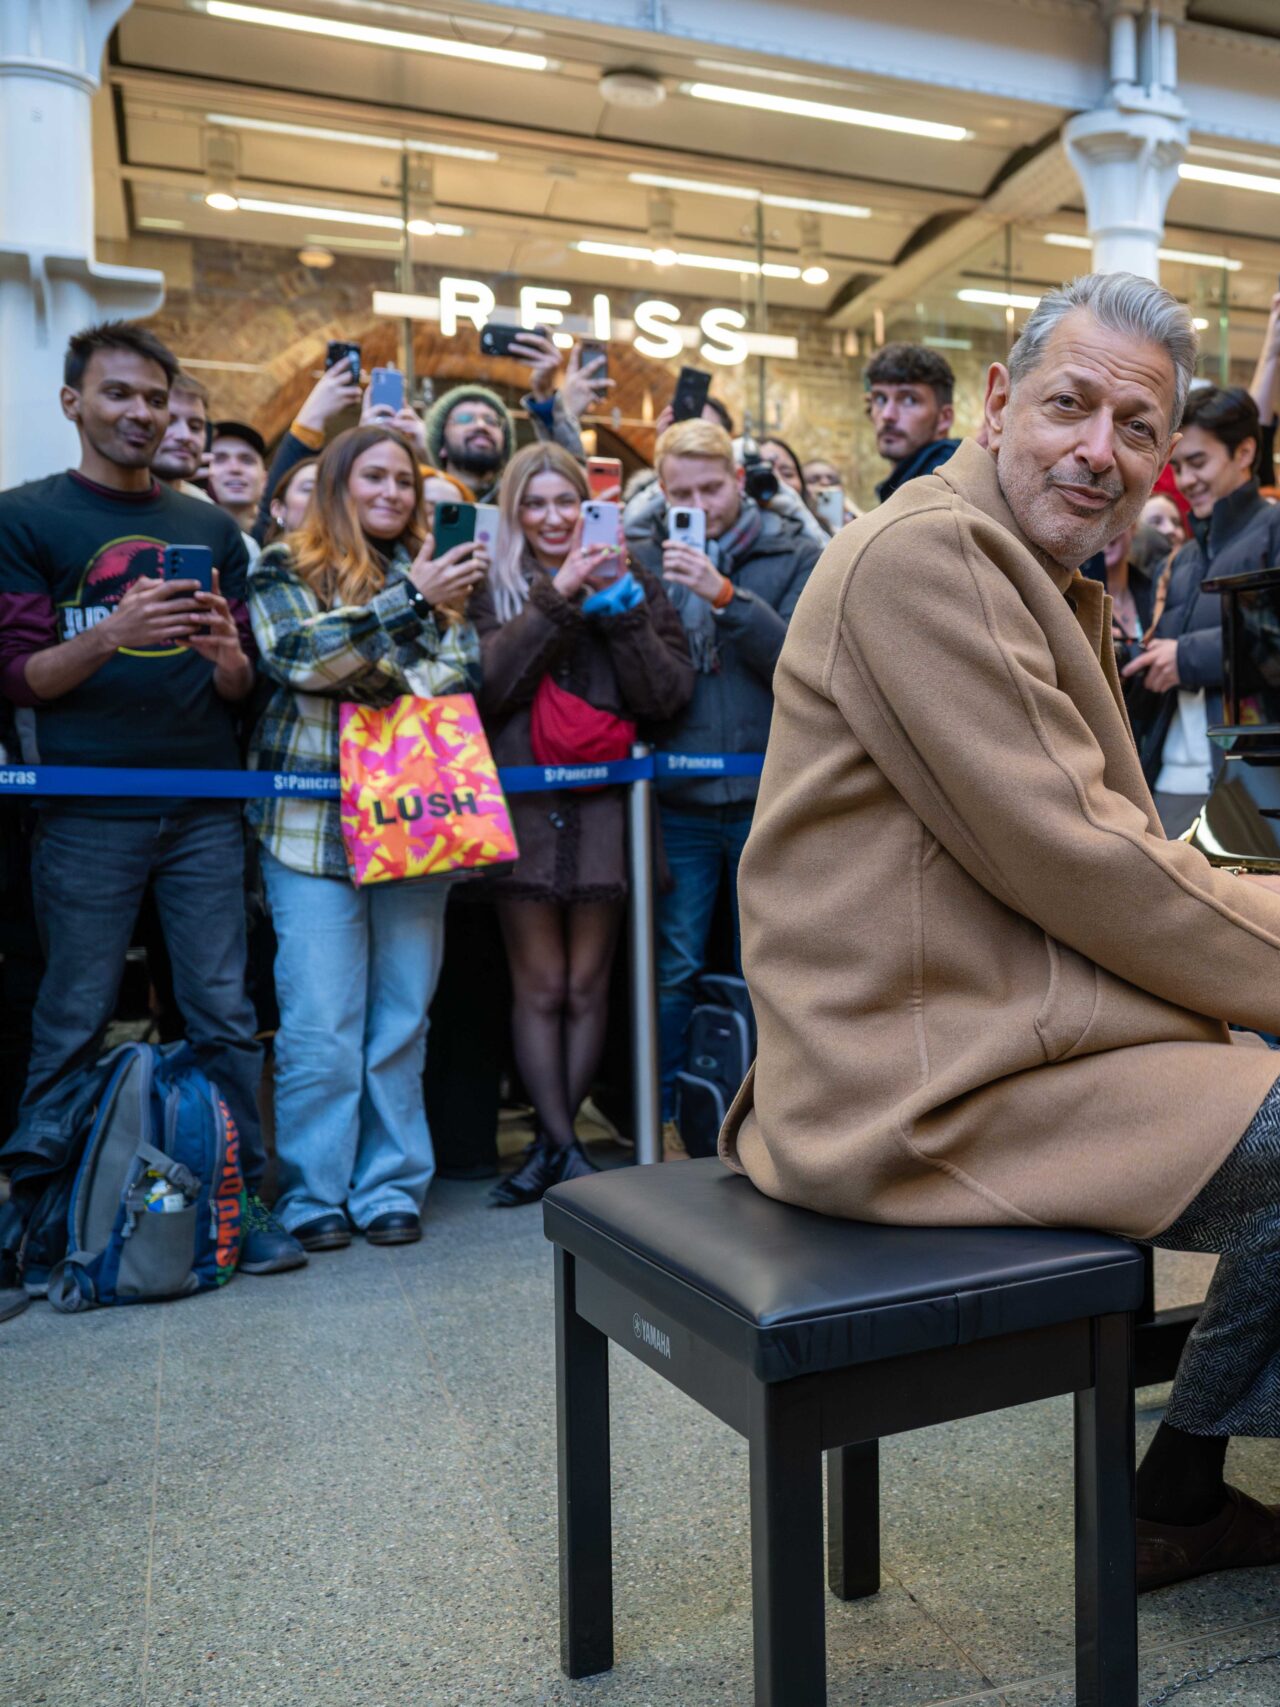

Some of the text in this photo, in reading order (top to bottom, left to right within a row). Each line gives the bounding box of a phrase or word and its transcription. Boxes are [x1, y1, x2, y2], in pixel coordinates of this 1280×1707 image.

[439, 276, 749, 366] REISS
[373, 792, 479, 825] LUSH
[640, 1318, 671, 1359] YAMAHA
